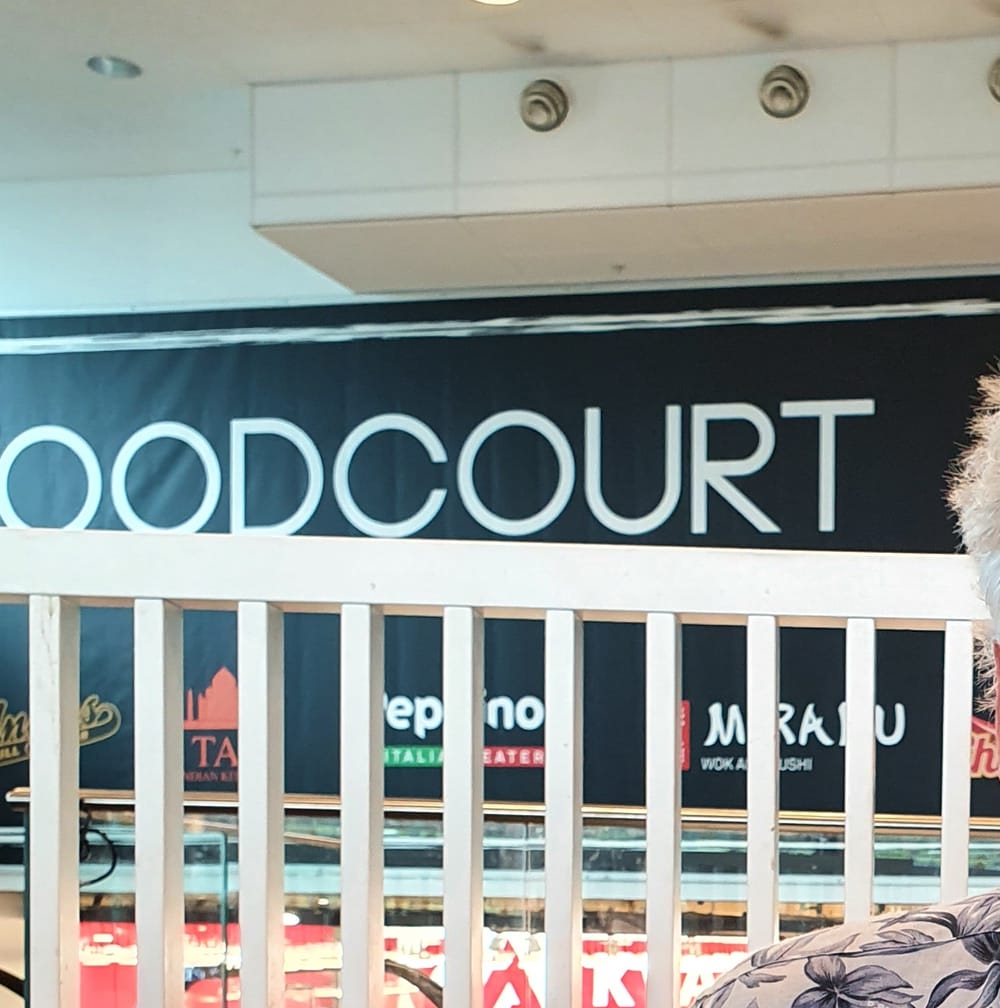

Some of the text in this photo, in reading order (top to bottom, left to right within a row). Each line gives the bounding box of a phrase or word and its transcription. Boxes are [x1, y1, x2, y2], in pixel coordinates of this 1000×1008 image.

[384, 687, 545, 740] epno
[703, 702, 906, 748] MRAU
[191, 735, 238, 769] TA
[484, 750, 545, 765] EATER
[700, 757, 734, 772] WOK
[779, 757, 814, 772] USHI
